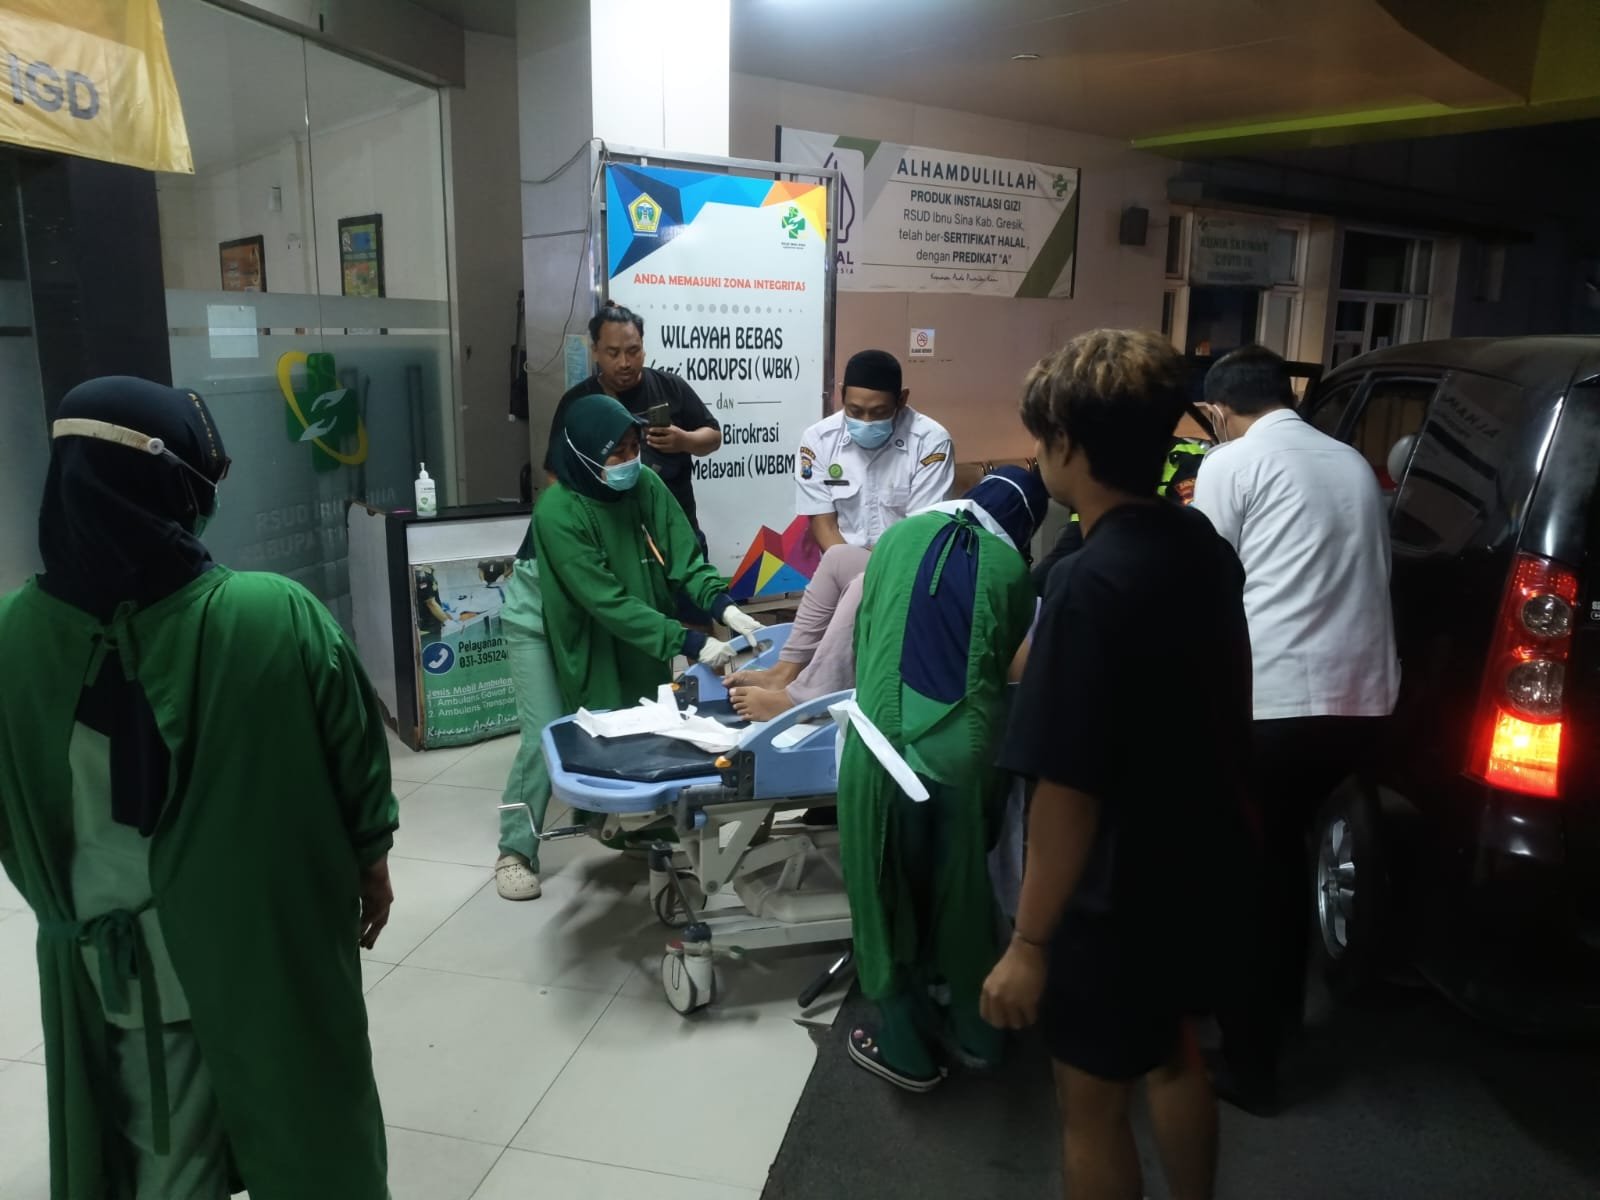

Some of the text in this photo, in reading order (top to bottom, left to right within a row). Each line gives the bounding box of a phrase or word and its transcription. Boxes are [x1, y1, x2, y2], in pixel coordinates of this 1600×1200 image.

[8, 53, 100, 120] IGD
[897, 158, 1037, 190] ALHAMDULILLAH
[910, 190, 1021, 212] PRODUK INSTALASI GIZI
[903, 209, 931, 222] RSUD
[932, 211, 952, 224] Ibnu
[954, 213, 974, 226] Sina
[975, 215, 994, 228] Kab.
[899, 229, 923, 241] telah
[925, 230, 996, 246] ber-SERTIFIKAT
[836, 250, 854, 265] AL
[916, 249, 950, 264] dengan
[952, 251, 996, 265] PREDIKAT
[633, 273, 806, 291] ANDA MEMASUKI ZONA INTEGRITAS
[661, 325, 783, 350] WILAYAH BEBAS
[686, 357, 752, 381] KORUPSI
[755, 356, 800, 381] (WBK)
[723, 421, 780, 445] Birokrasi
[748, 454, 796, 479] (WBBM
[458, 638, 502, 653] Pelayanan
[459, 650, 508, 668] 031-395124
[453, 683, 476, 694] Mobil
[479, 677, 513, 690] Ambulan
[438, 704, 481, 716] Ambulans
[482, 697, 515, 708] Transpor
